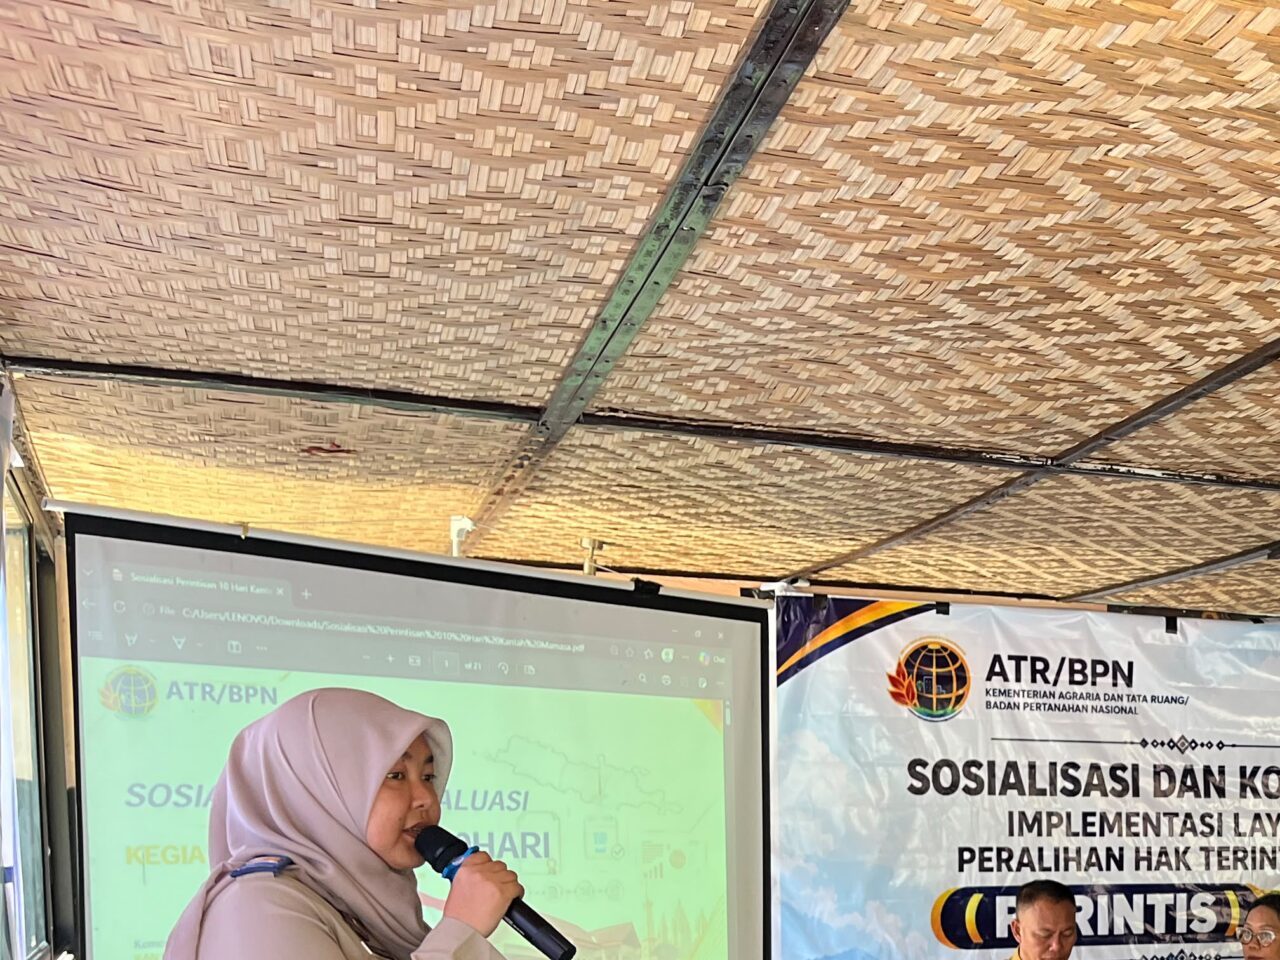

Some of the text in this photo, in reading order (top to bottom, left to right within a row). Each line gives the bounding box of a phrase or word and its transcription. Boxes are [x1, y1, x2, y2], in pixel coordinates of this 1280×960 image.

[985, 654, 1134, 688] ATR/BPN
[167, 681, 278, 705] ATR/BPN
[985, 688, 1189, 706] KEMENTERIAN AGRARIA DAN TATA RUANG/
[985, 701, 1139, 716] BADAN PERTANAHAN NASIONAL
[906, 758, 1140, 797] SOSIALISASI
[1153, 764, 1226, 798] DAN
[441, 789, 529, 811] ALUASI
[1007, 810, 1224, 838] IMPLEMENTASI
[125, 844, 207, 865] KEGIA
[957, 847, 1125, 873] PERALIHAN
[1135, 846, 1194, 872] HAK
[995, 891, 1217, 939] PRINTIS
